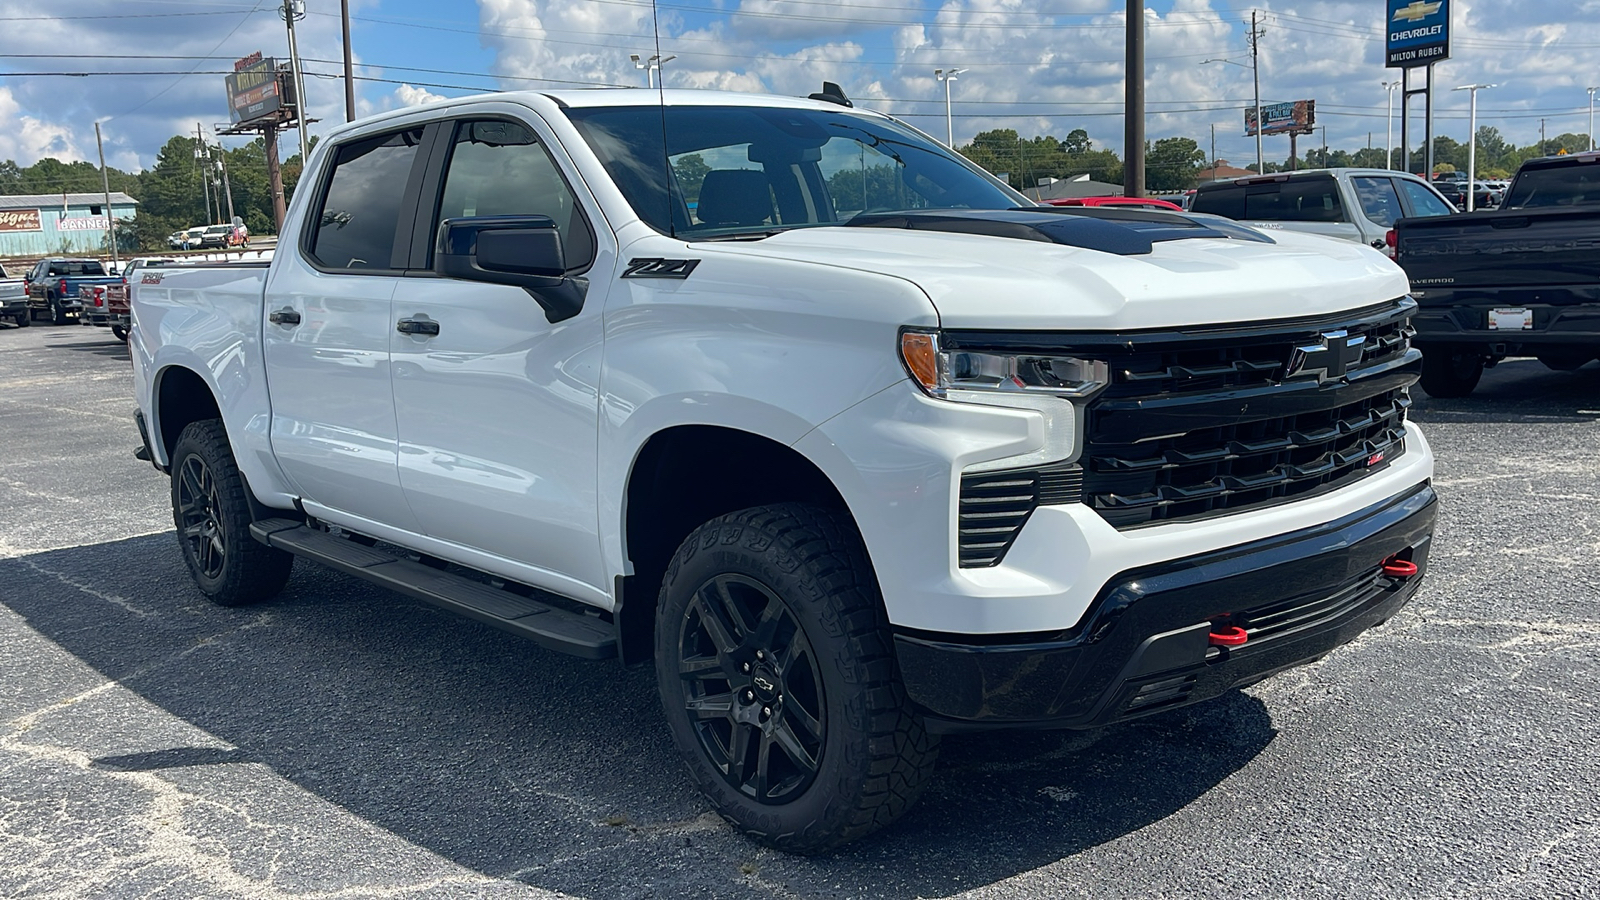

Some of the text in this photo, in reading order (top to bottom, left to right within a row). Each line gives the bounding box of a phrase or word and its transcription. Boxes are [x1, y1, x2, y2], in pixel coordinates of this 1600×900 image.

[1391, 25, 1443, 41] CHEVROLET
[1391, 46, 1443, 62] MILTON RUBEN
[620, 257, 701, 279] Z71
